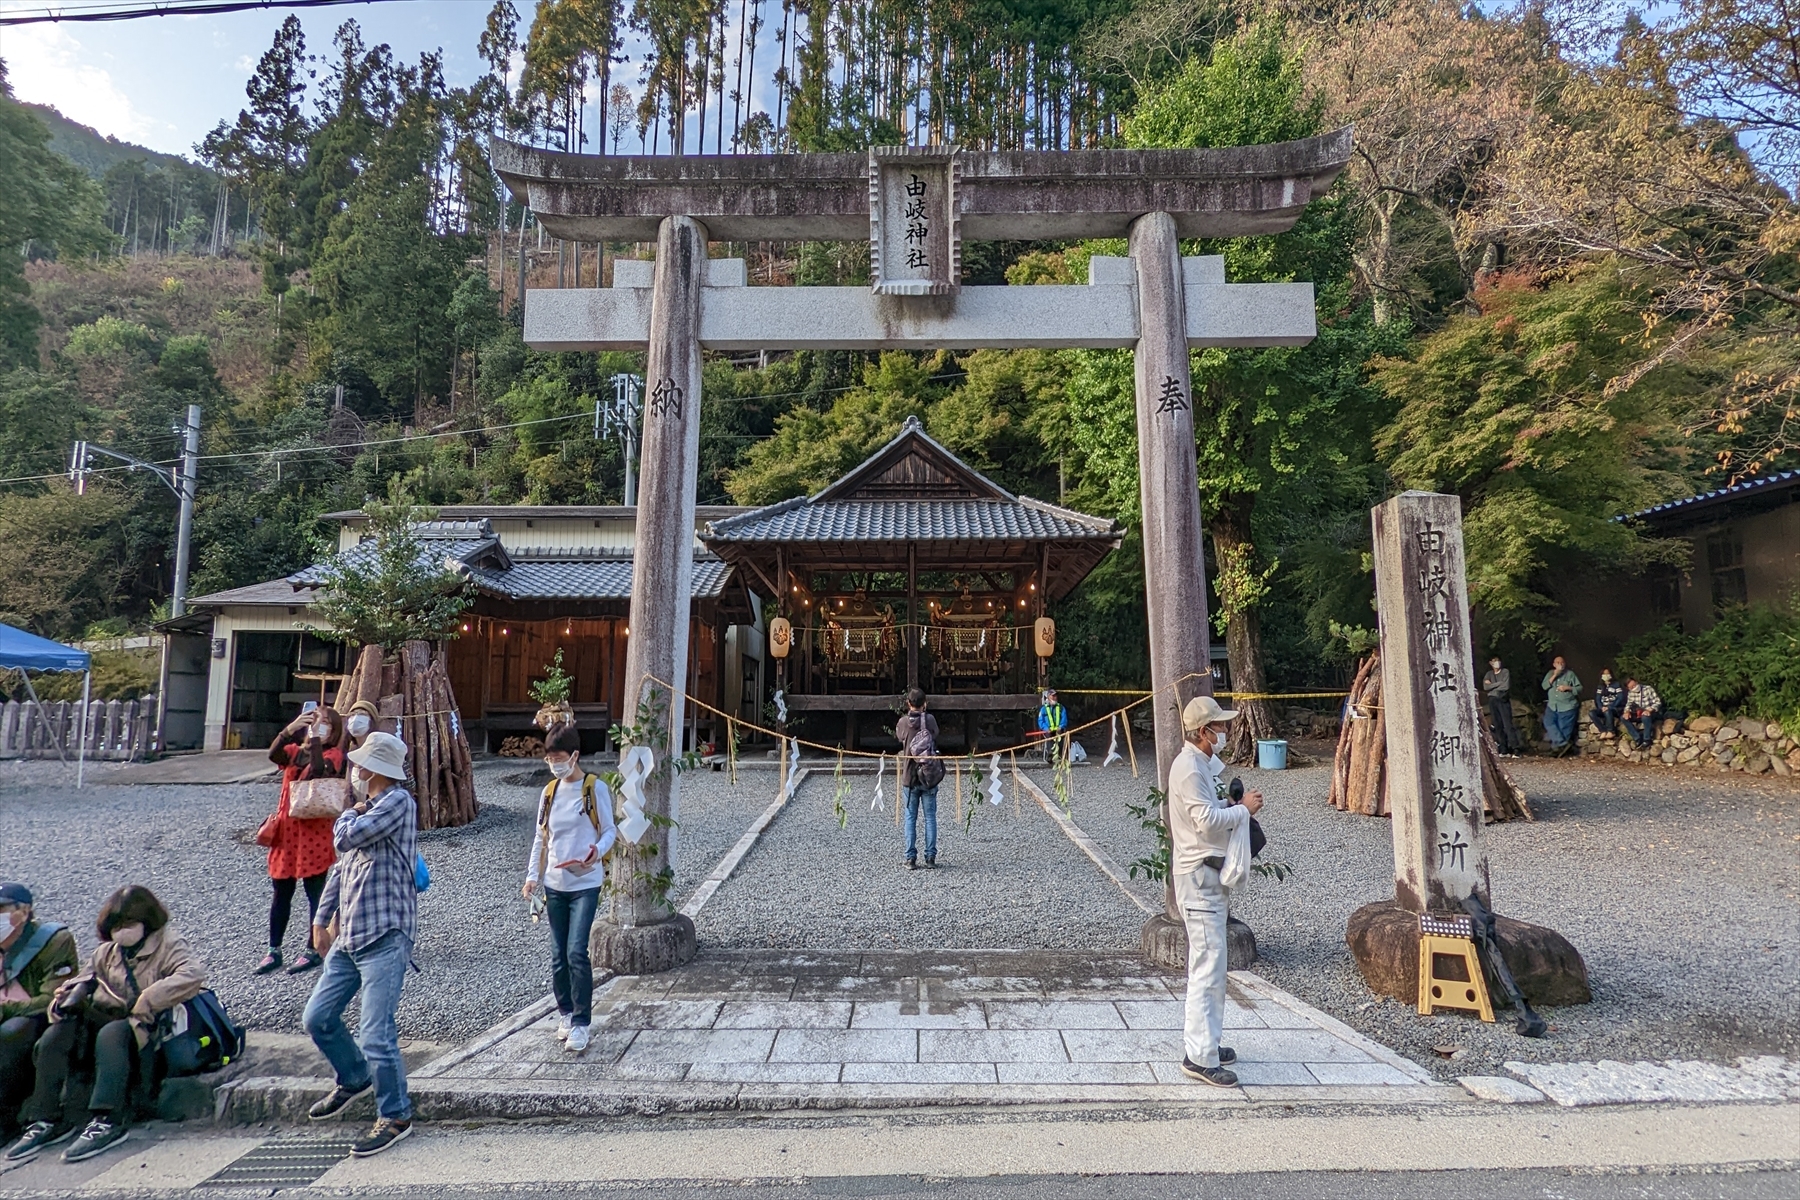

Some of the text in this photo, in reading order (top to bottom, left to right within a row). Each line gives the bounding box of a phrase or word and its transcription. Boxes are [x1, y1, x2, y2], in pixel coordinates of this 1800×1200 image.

[904, 174, 930, 270] 由岐神社
[651, 377, 683, 420] 納
[1155, 375, 1189, 420] 奉
